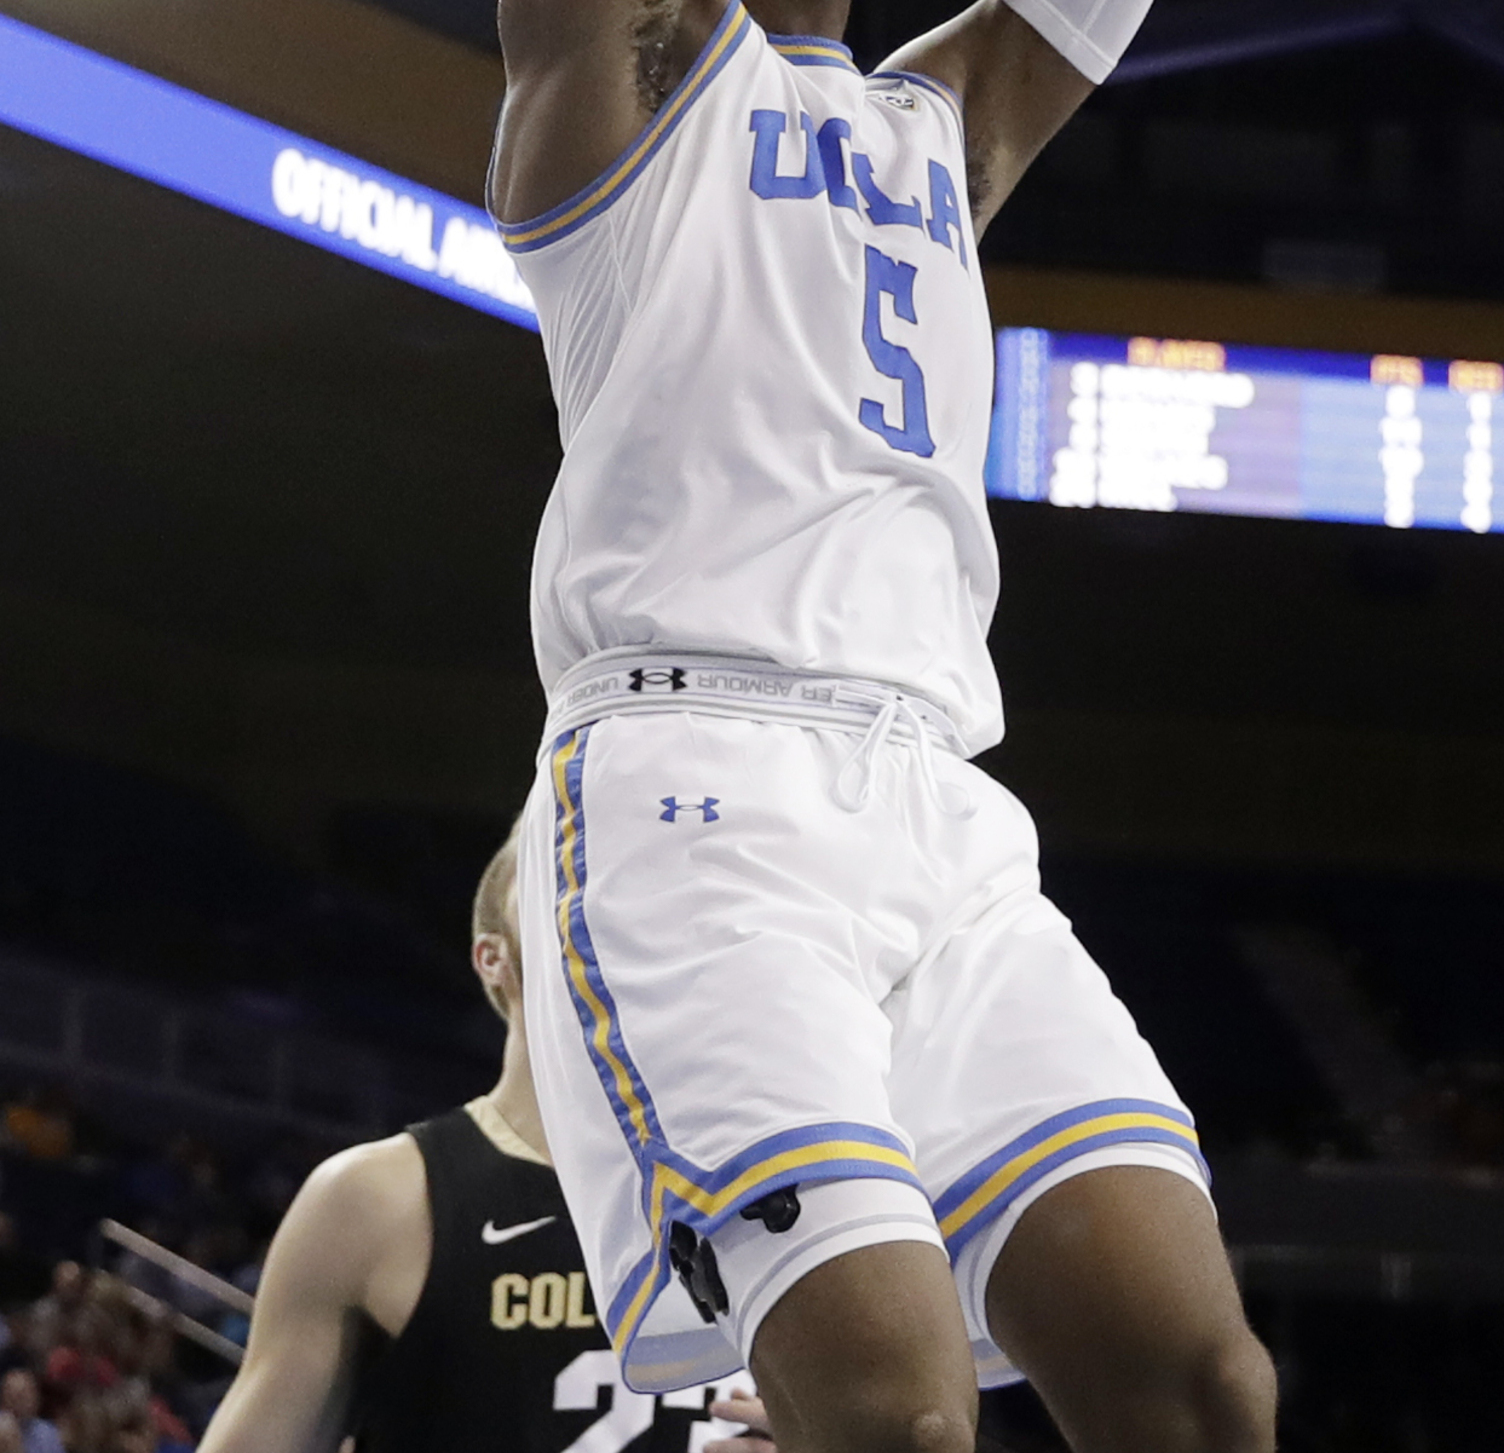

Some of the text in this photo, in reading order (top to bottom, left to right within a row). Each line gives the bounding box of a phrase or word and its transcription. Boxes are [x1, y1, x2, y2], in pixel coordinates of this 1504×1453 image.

[272, 147, 438, 272] OFFICIAL
[748, 108, 968, 269] UCLA
[858, 244, 937, 459] 5
[567, 677, 618, 706] UNDER
[697, 674, 793, 699] ARMOUR
